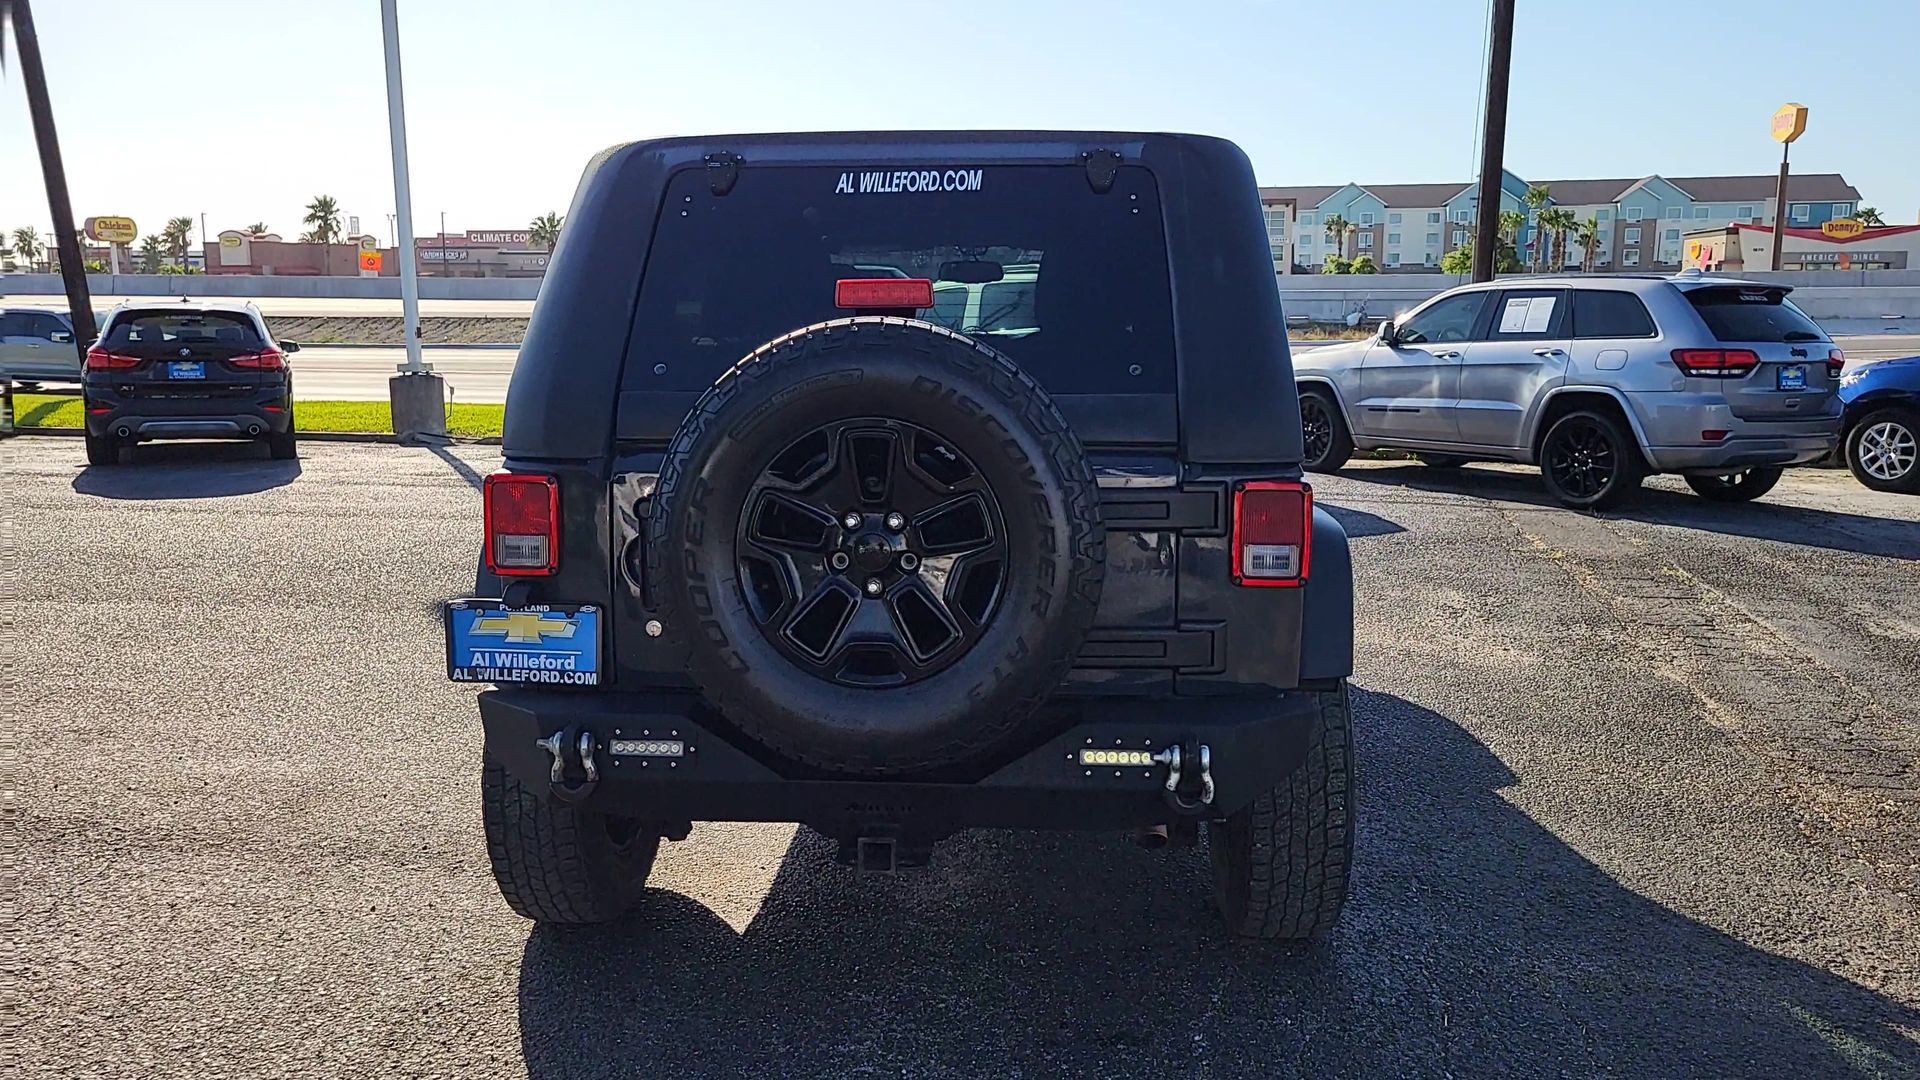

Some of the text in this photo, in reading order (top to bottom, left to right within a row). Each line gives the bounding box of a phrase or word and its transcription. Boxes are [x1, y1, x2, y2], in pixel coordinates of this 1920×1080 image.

[835, 169, 983, 194] AL WILLEFORD.COM
[1828, 223, 1860, 233] Denny's
[470, 233, 512, 243] CLIMATE
[1852, 253, 1880, 261] DINER
[910, 375, 1056, 620] DISCOVERER
[470, 652, 576, 671] Al Willeford
[453, 668, 598, 686] AL WILLEFORD.COM
